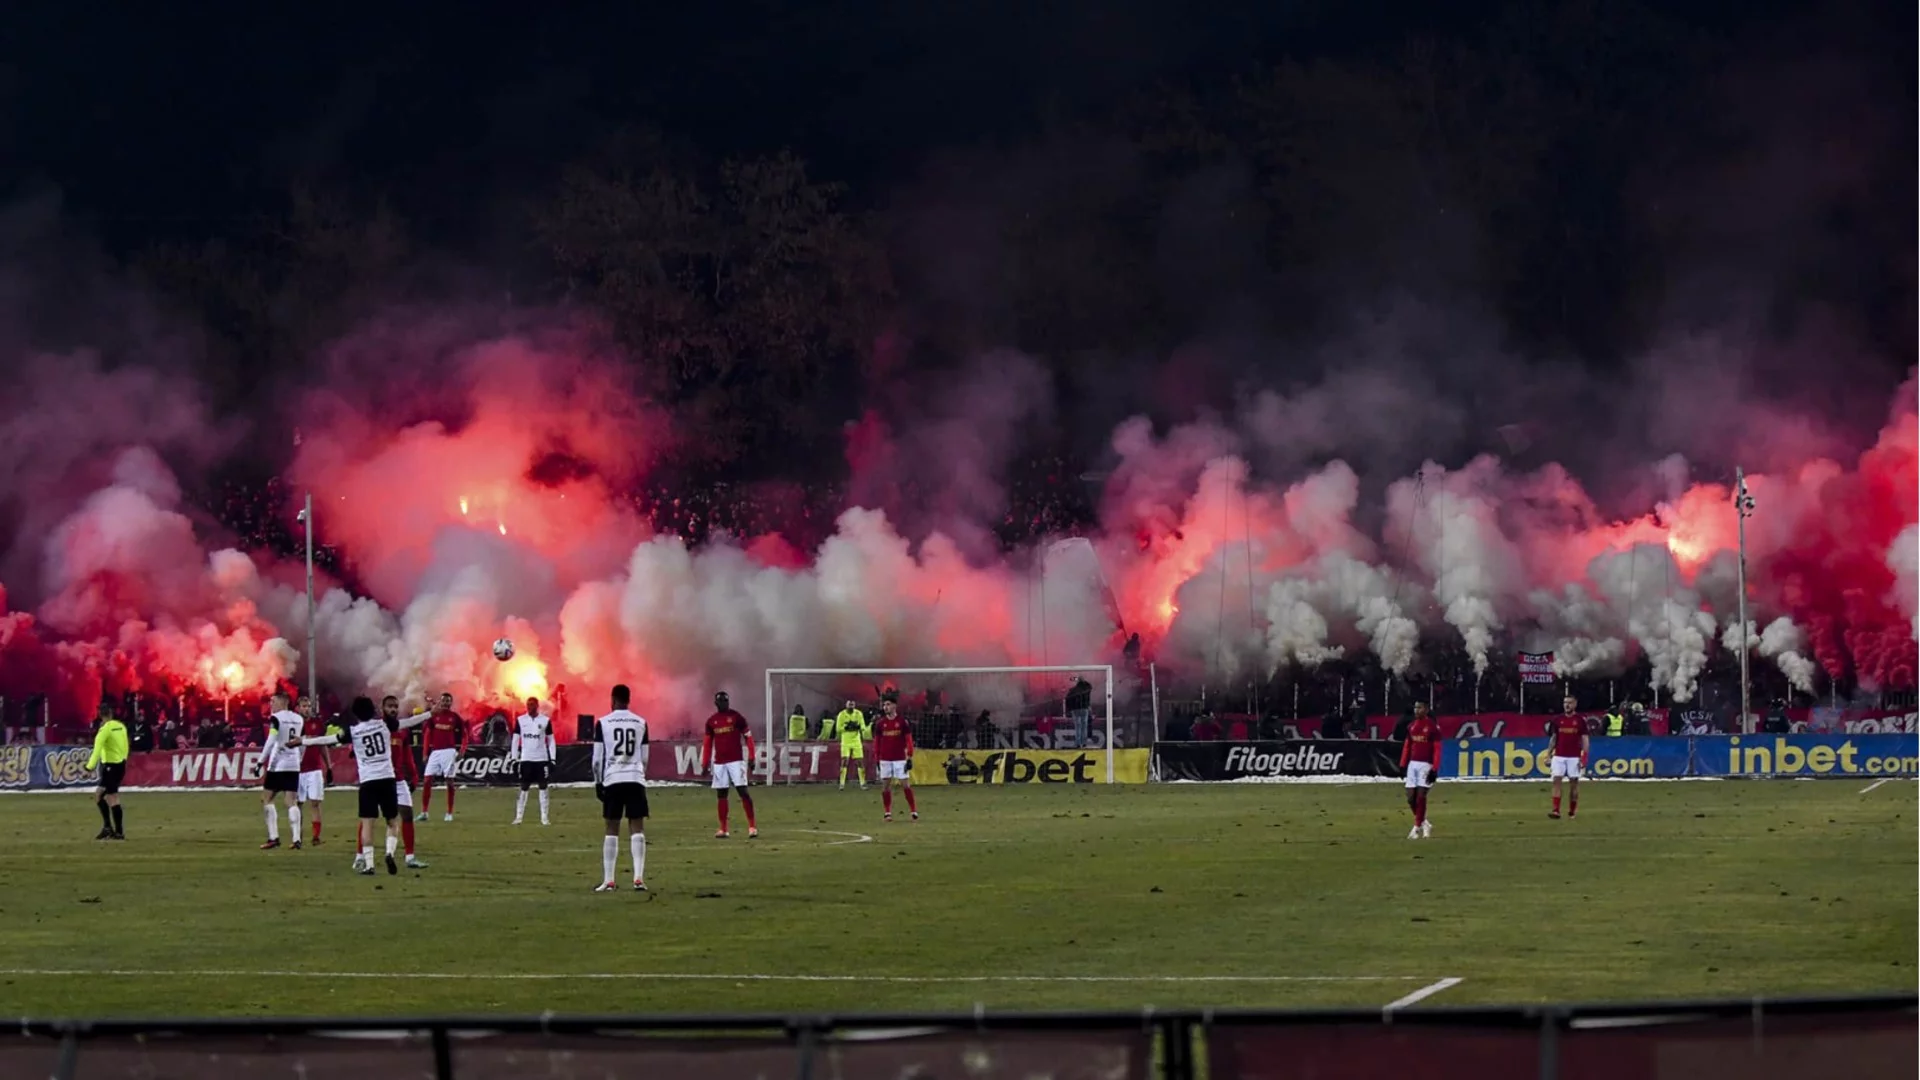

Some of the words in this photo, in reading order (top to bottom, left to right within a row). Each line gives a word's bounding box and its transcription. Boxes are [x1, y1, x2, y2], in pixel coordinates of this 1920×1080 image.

[362, 731, 386, 757] 30
[613, 727, 636, 757] 26
[944, 752, 1096, 784] efbet
[1224, 745, 1343, 775] Fitogether
